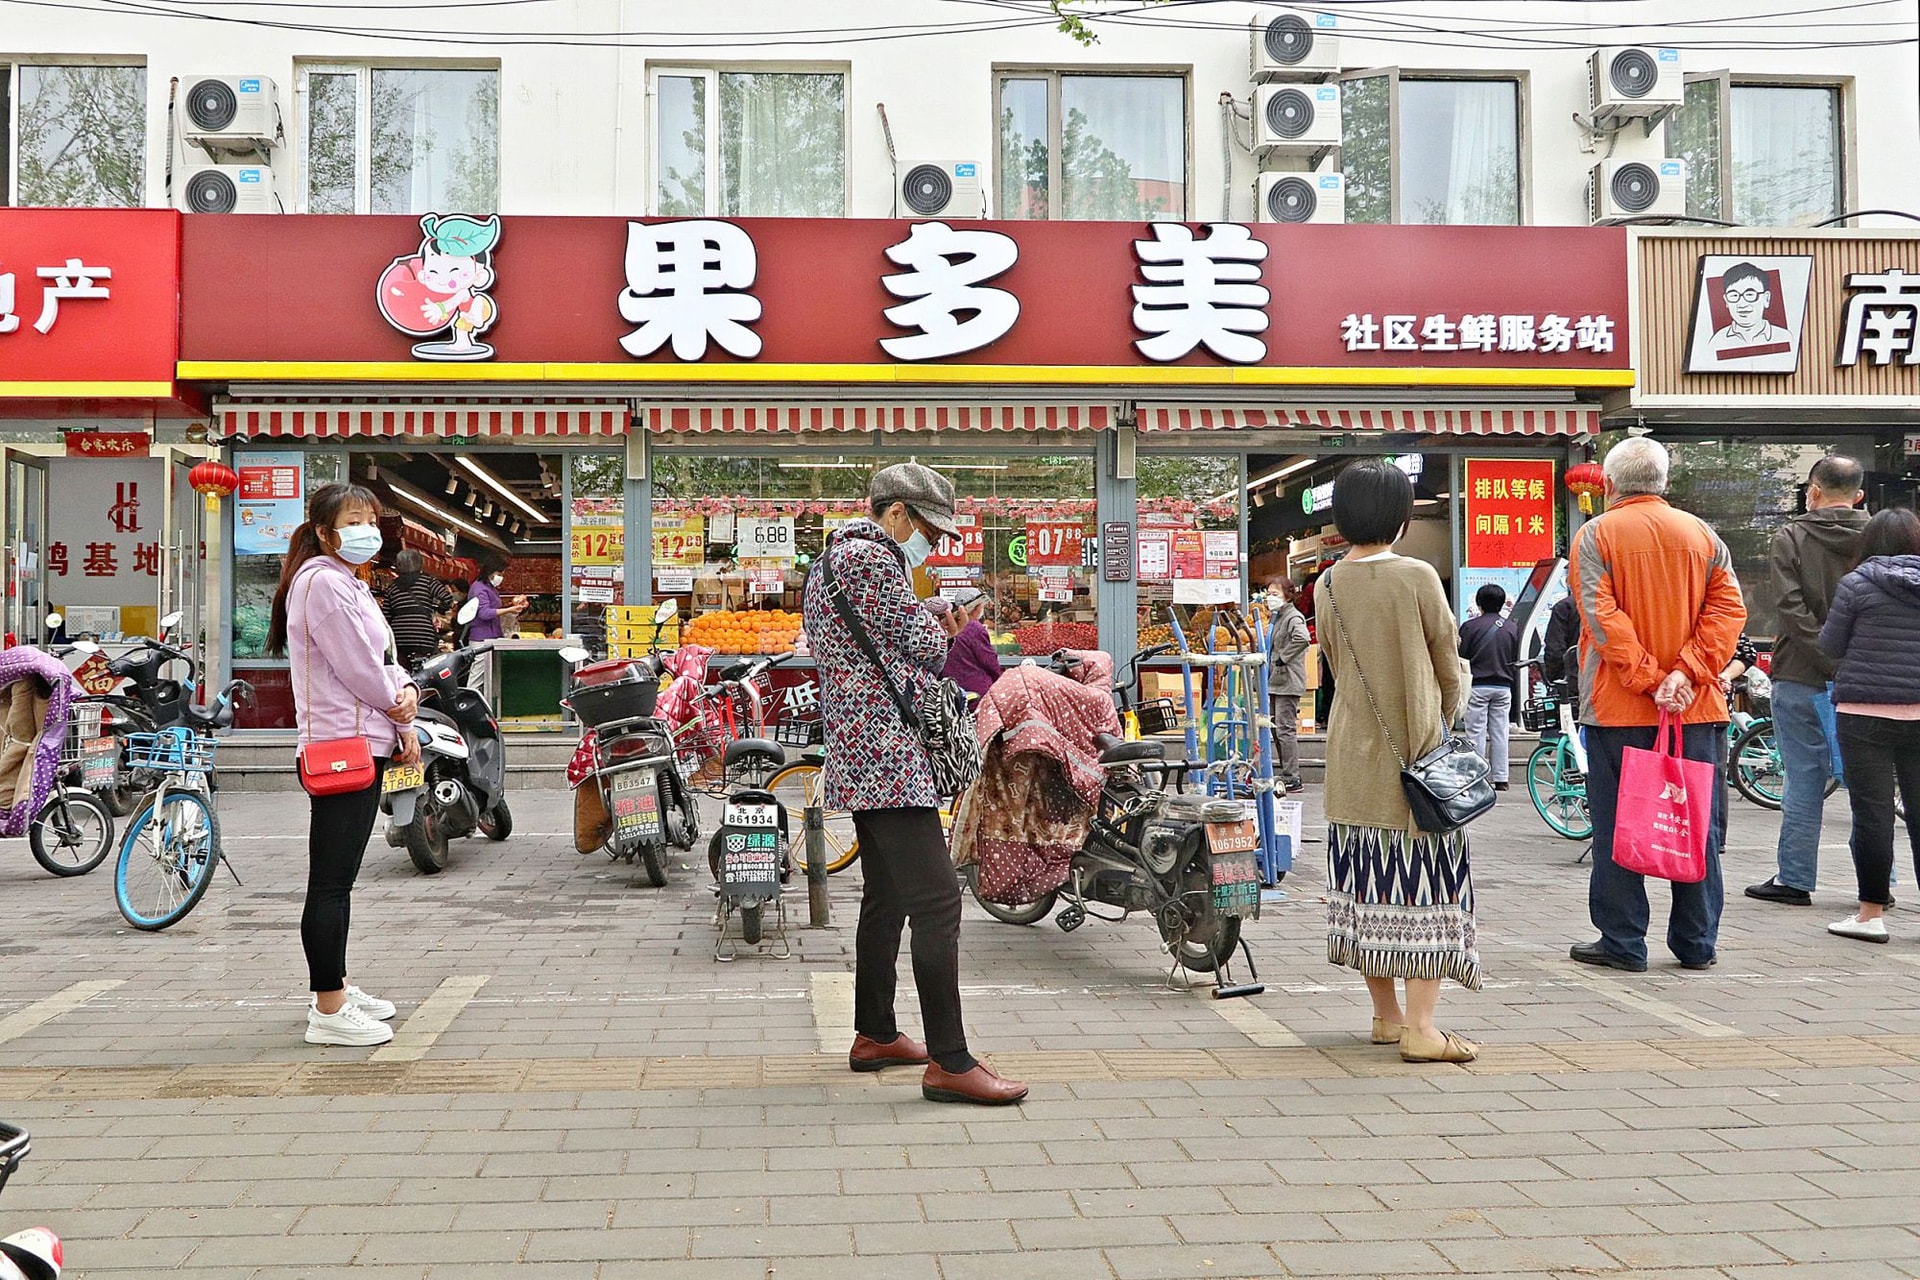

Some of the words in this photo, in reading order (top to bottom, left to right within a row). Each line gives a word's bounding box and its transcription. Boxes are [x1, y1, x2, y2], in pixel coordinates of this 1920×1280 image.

[617, 220, 1271, 364] 果多美
[1840, 268, 1920, 367] 南
[1341, 313, 1616, 354] 社区生鲜服务站
[1474, 477, 1546, 501] 排队等候
[754, 526, 788, 544] 6.88
[1474, 513, 1546, 536] 间隔1米
[582, 533, 608, 557] 12
[659, 535, 684, 559] 12
[1038, 528, 1064, 556] 07
[729, 814, 773, 824] 861934
[747, 833, 776, 848] 绿源
[1212, 836, 1254, 850] 1067952
